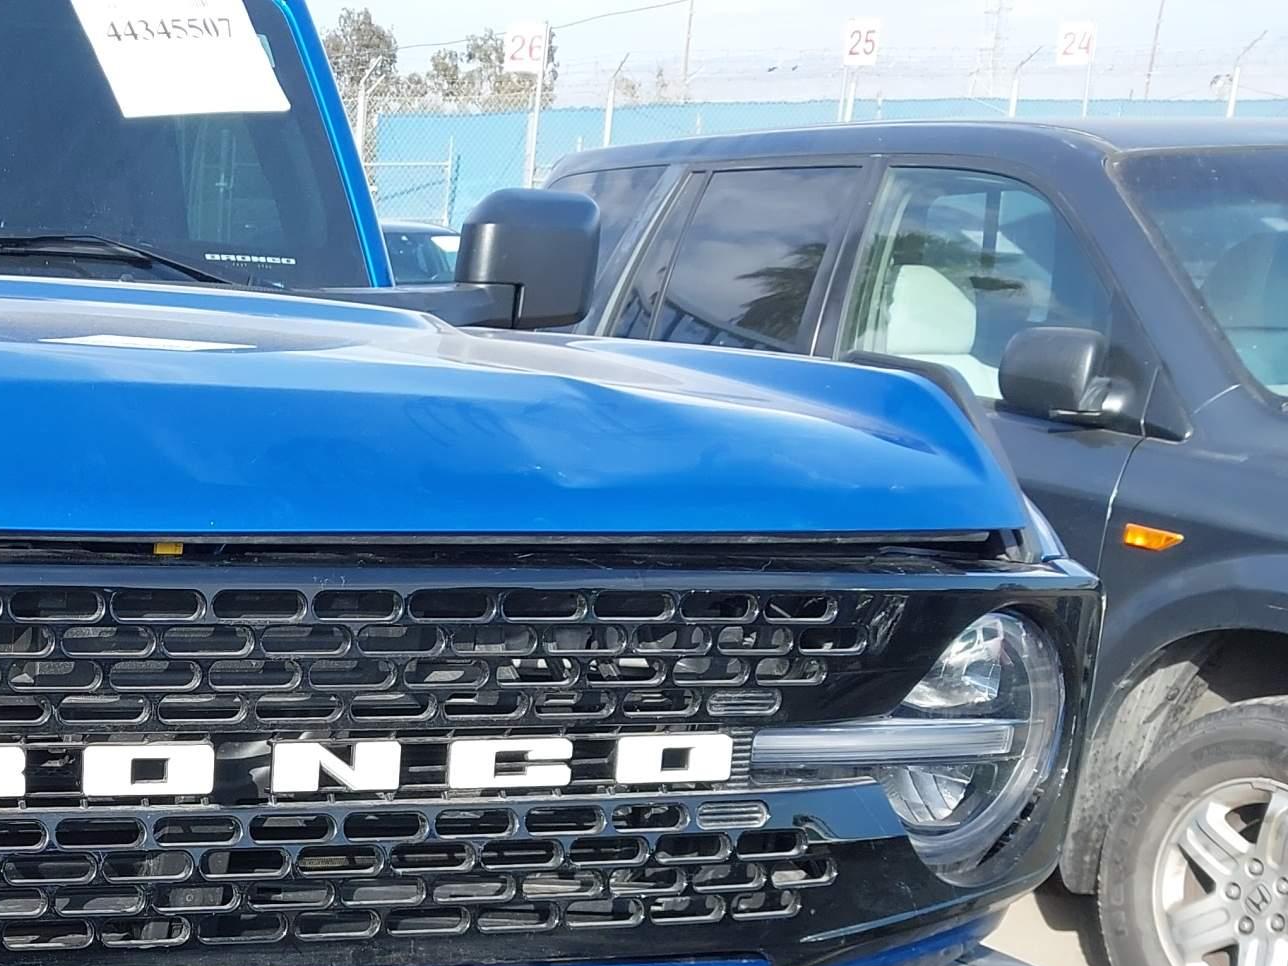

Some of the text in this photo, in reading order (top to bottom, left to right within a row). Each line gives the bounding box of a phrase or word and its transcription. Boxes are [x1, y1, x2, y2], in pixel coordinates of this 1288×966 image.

[107, 18, 231, 41] 44345507
[510, 35, 543, 60] 26
[848, 29, 876, 55] 25
[1062, 31, 1092, 55] 24
